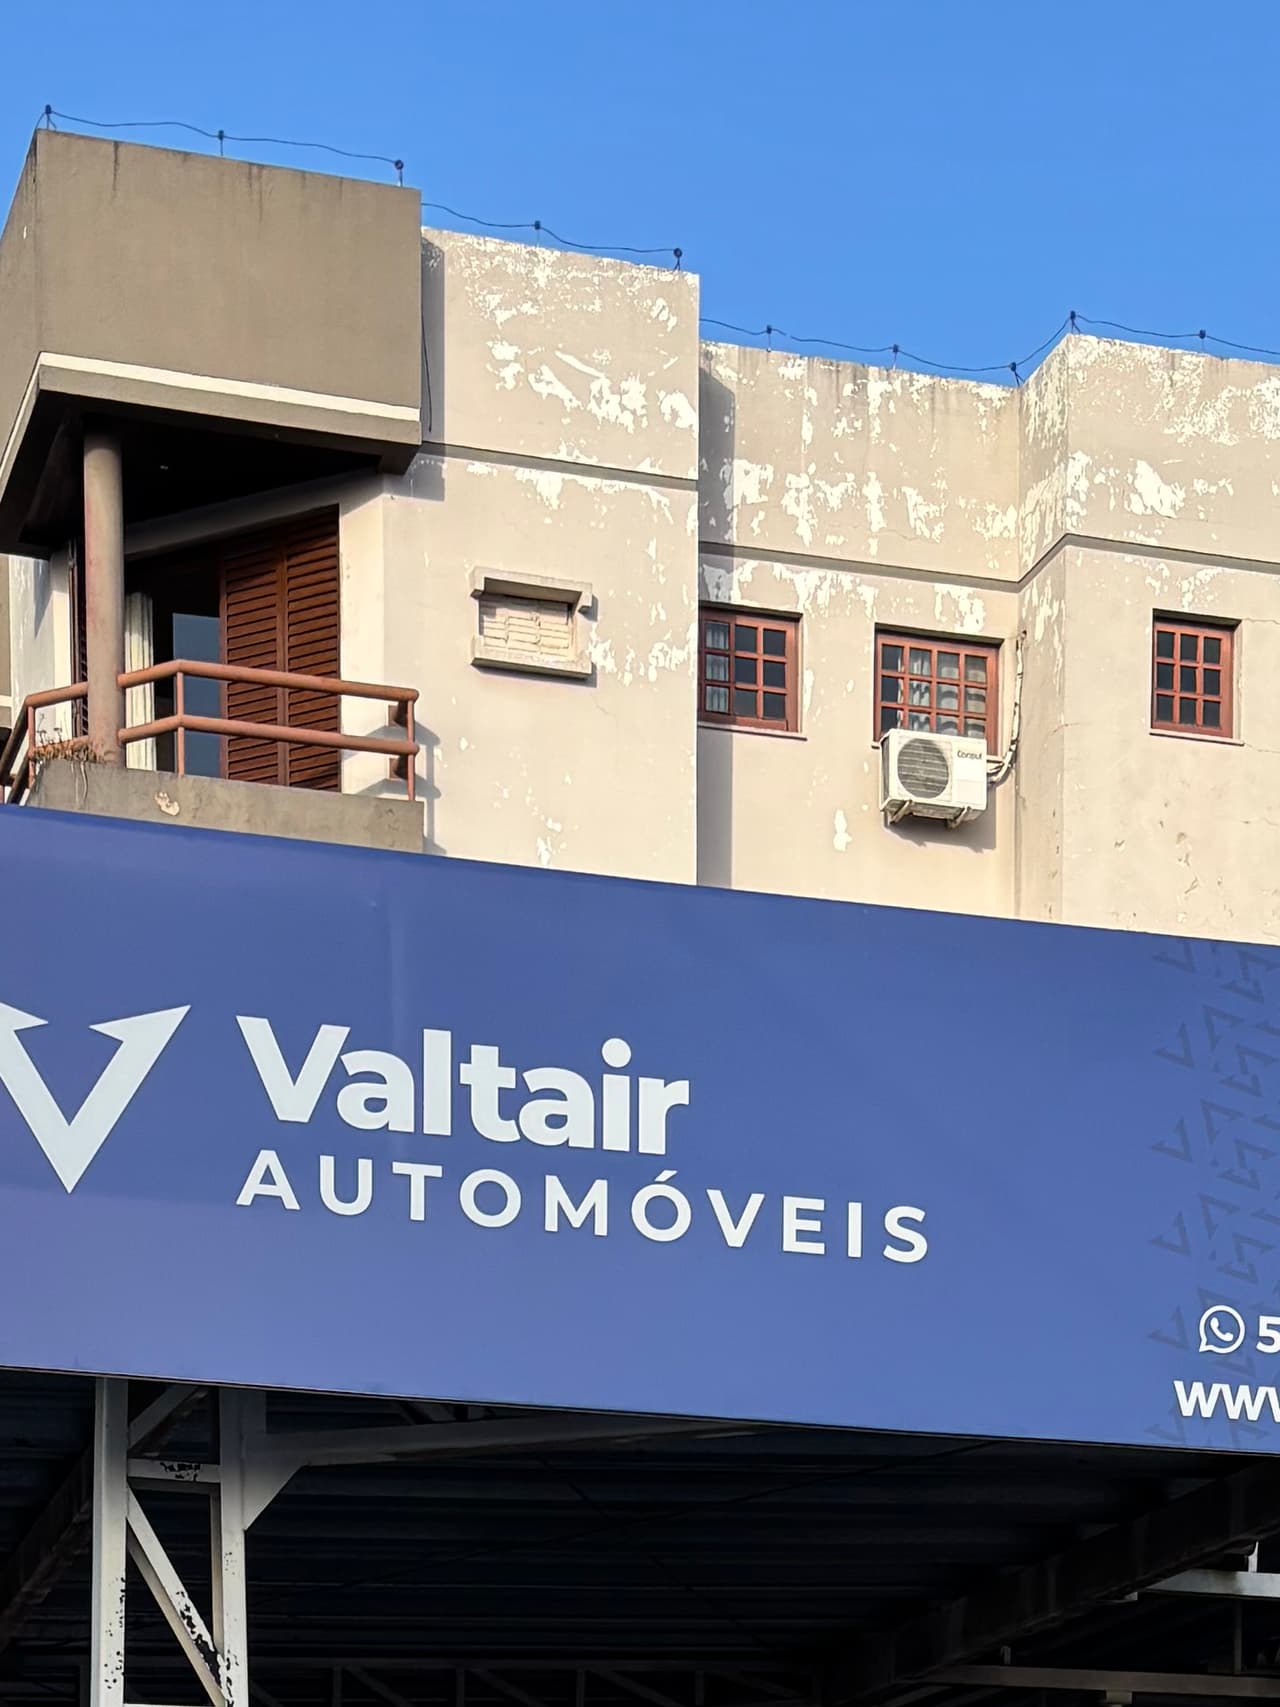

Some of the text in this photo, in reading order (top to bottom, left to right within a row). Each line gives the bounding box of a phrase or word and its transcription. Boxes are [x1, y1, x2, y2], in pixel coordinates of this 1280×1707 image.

[957, 749, 983, 760] Consul
[235, 1015, 691, 1156] Valtair
[236, 1149, 929, 1263] AUTOMÓVEIS
